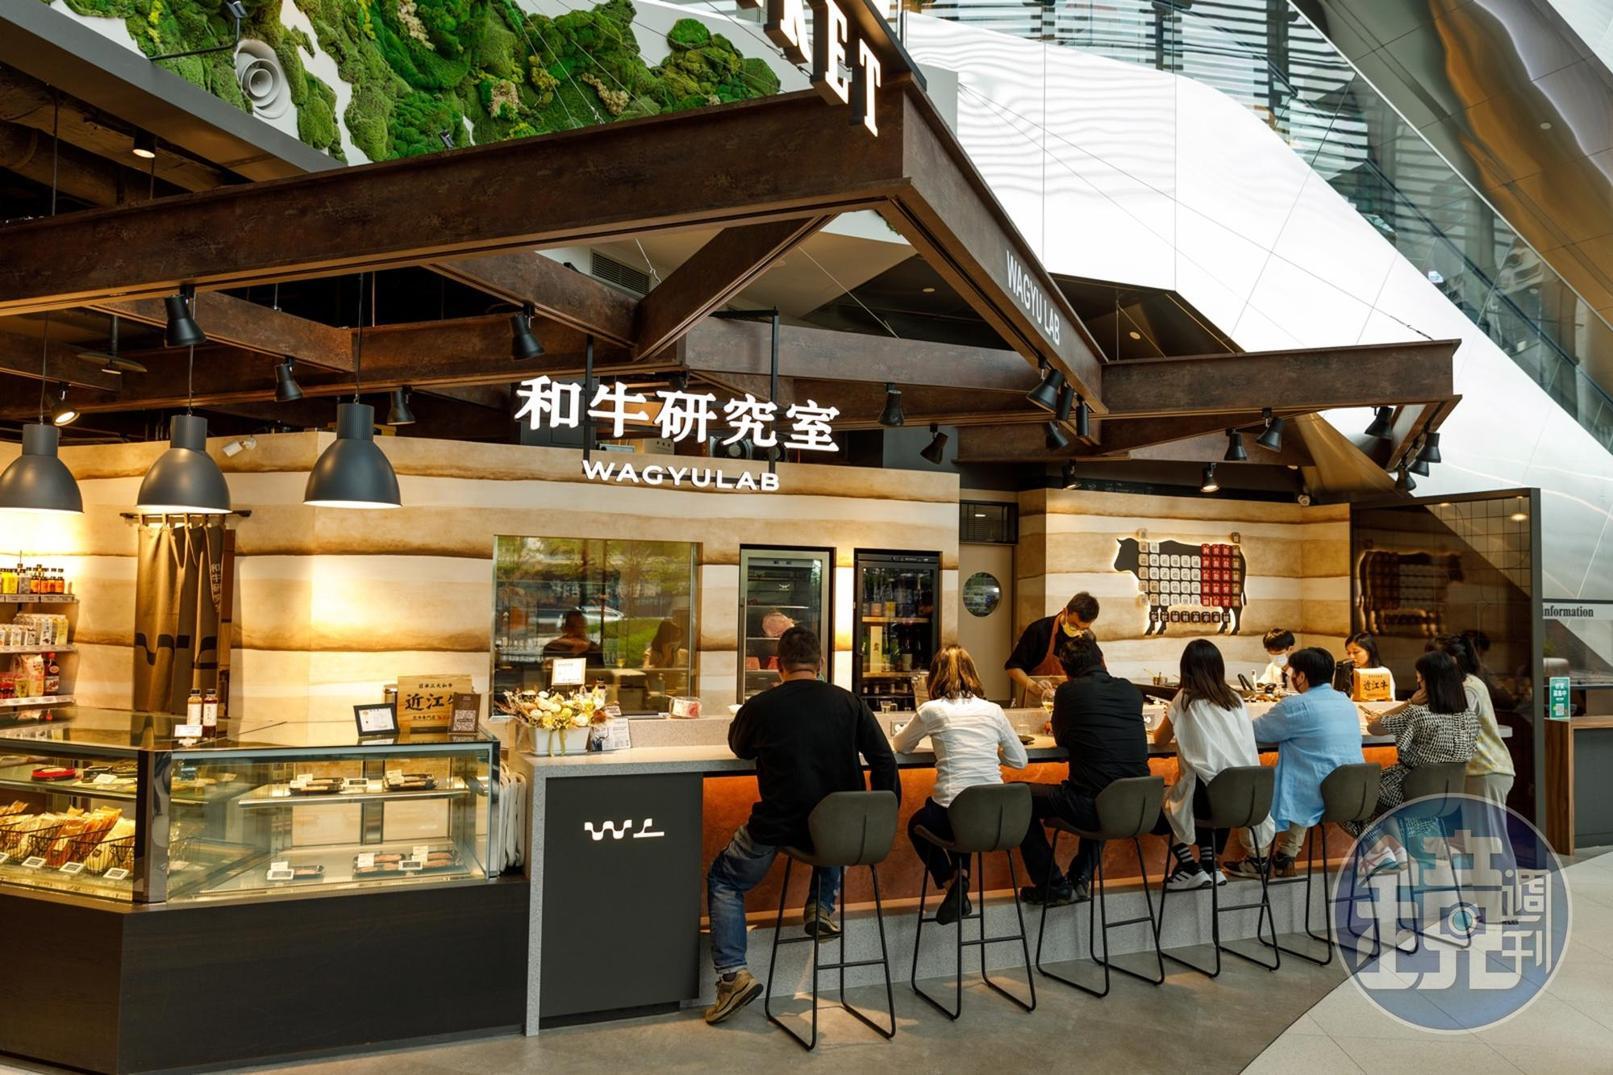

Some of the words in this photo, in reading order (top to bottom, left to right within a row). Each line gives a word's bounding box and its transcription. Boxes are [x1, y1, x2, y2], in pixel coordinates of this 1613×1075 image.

[1006, 249, 1043, 324] WAGYU
[1044, 299, 1060, 346] LAB
[514, 375, 840, 452] 和牛研究室
[582, 459, 780, 491] WAGYULAB
